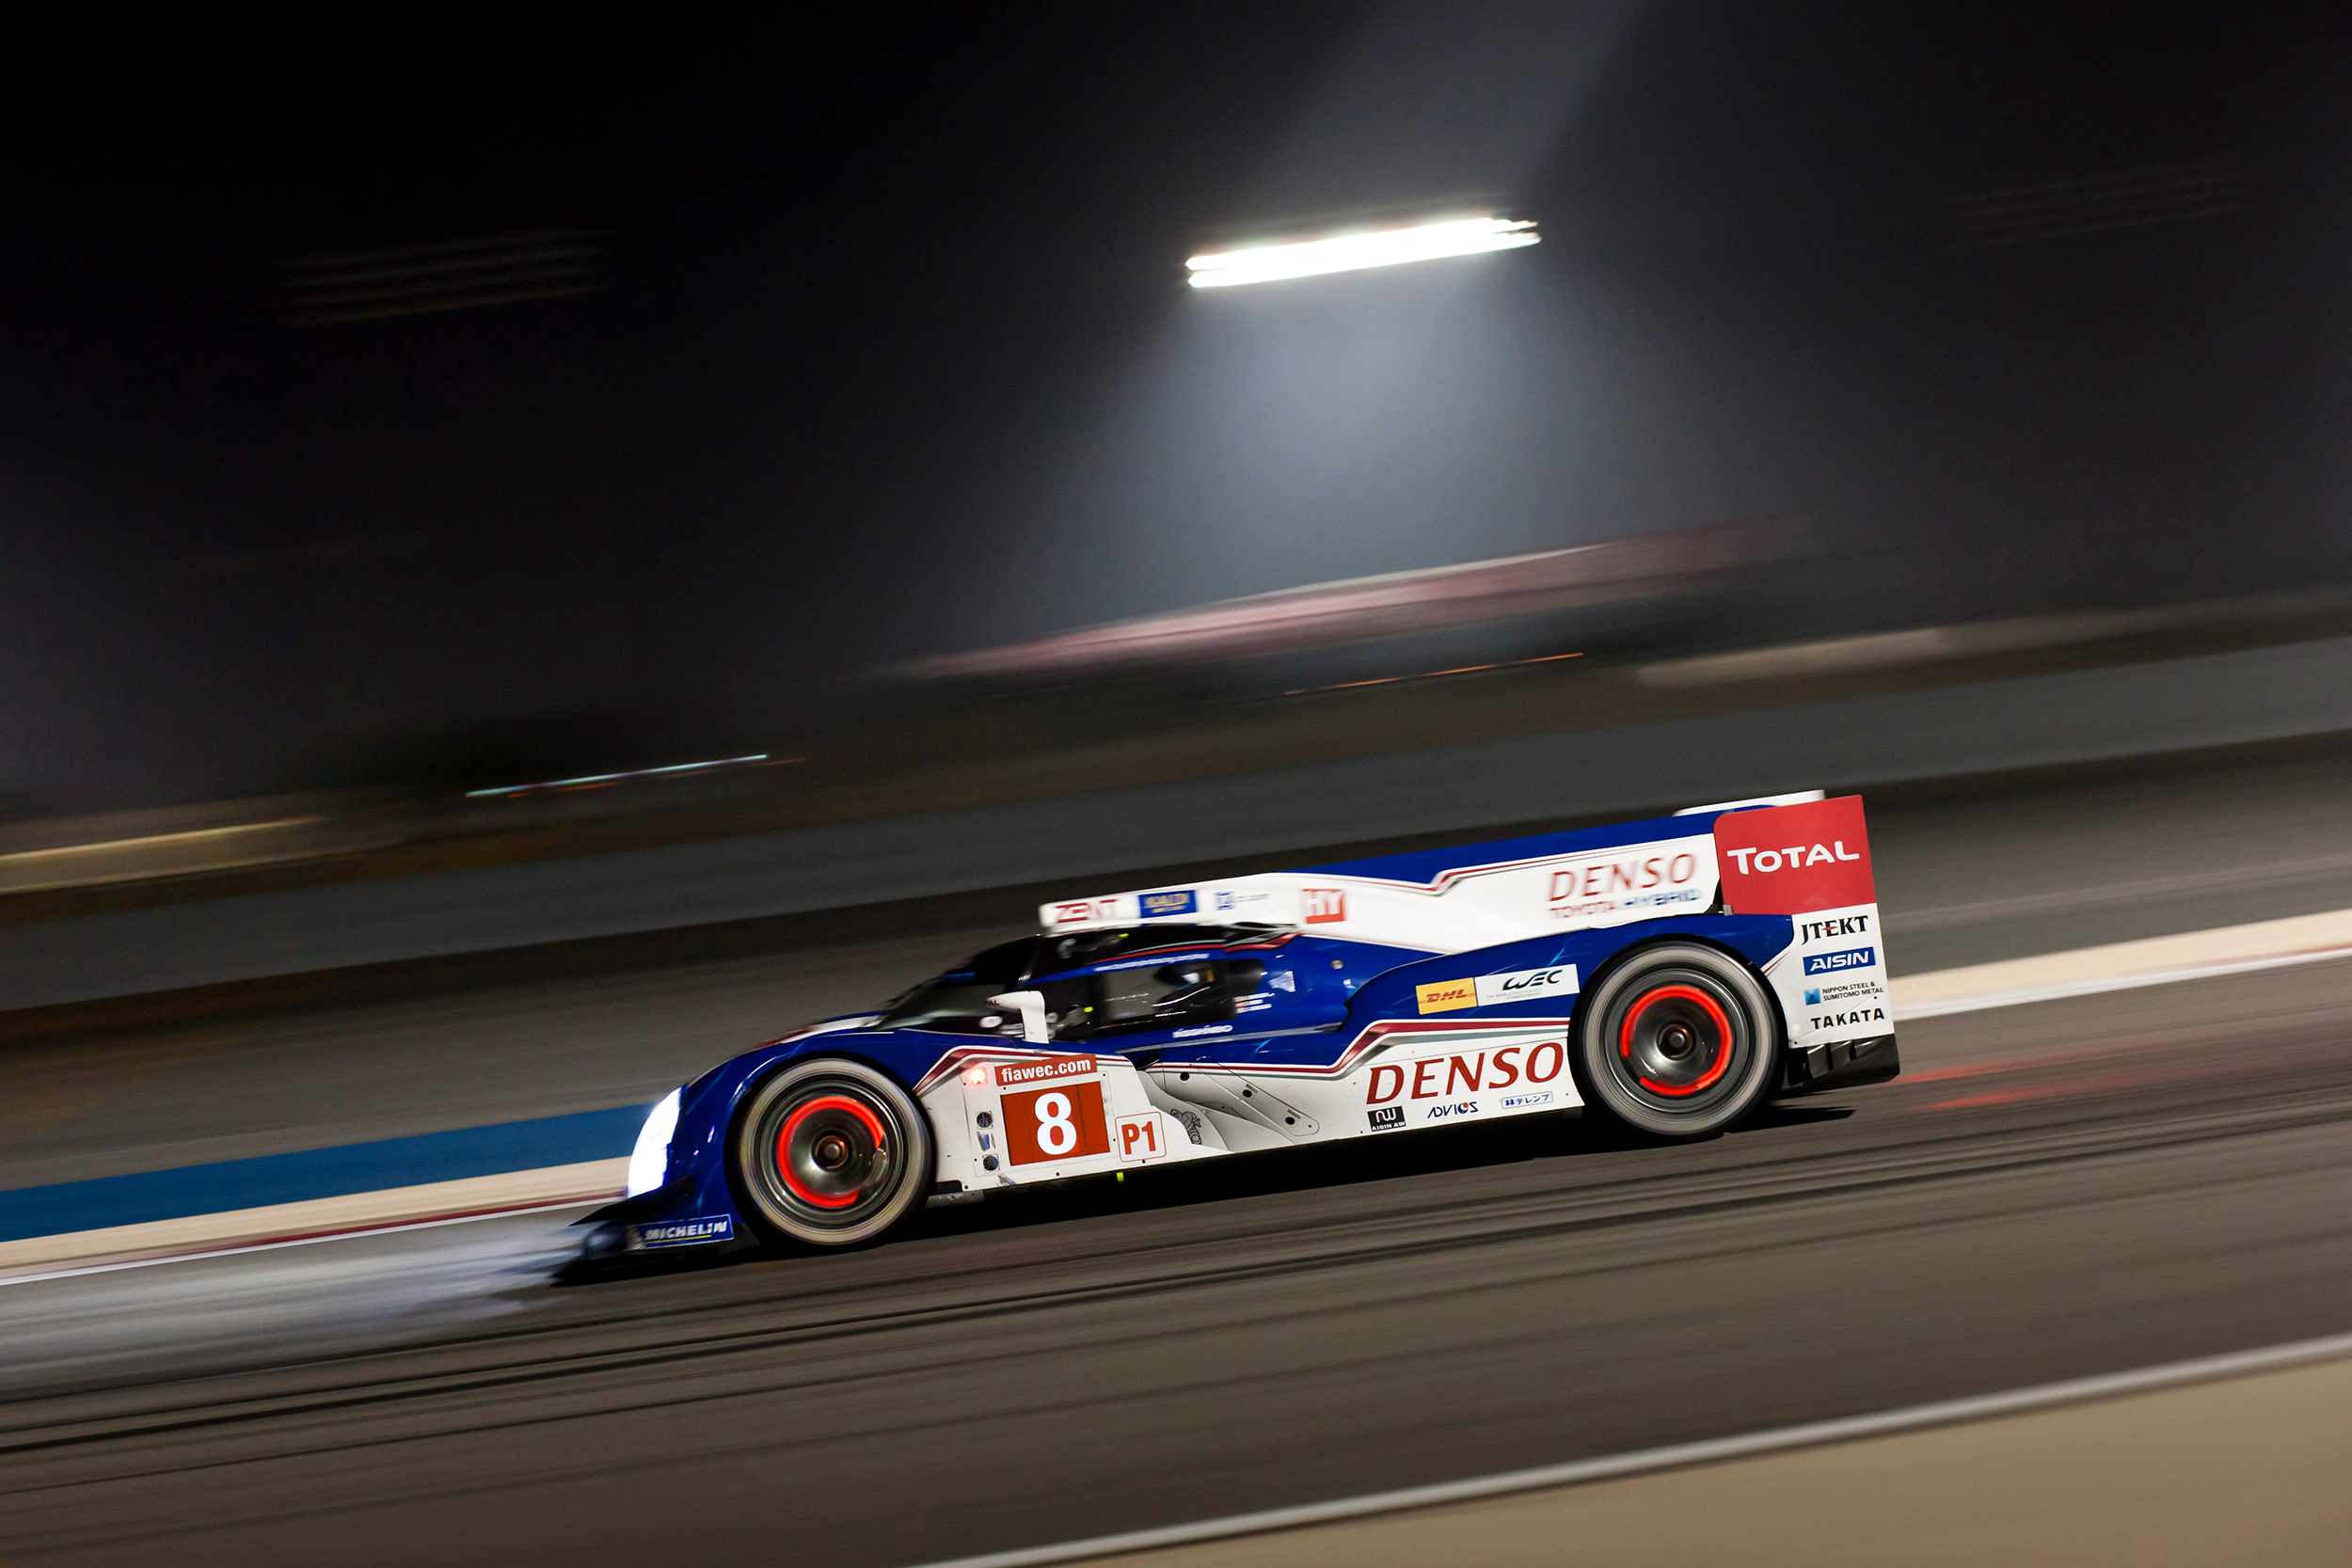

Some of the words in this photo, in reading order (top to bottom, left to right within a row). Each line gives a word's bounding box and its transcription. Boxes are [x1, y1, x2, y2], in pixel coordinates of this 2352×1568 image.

[1727, 840, 1860, 876] TOTAL
[1549, 853, 1697, 902] DENSO
[1055, 898, 1118, 923] ZENT
[1801, 915, 1869, 945] JTEKT
[1810, 950, 1869, 972] AISIN
[1502, 969, 1564, 990] WEC
[1822, 985, 1849, 994] NIPPON
[1849, 982, 1869, 990] STEEL
[1425, 989, 1469, 1004] DHL
[1823, 990, 1860, 1001] SUMITOMO
[1861, 987, 1884, 995] METAL
[1811, 1007, 1884, 1030] TAKATA
[1001, 1058, 1091, 1083] fiawec.com
[1366, 1041, 1564, 1105] DENSO
[1427, 1101, 1478, 1118] ADVICS
[1034, 1092, 1077, 1155] 8
[1372, 1123, 1392, 1132] AISIN
[1121, 1120, 1156, 1155] P1
[644, 1221, 728, 1241] MICHELIN
